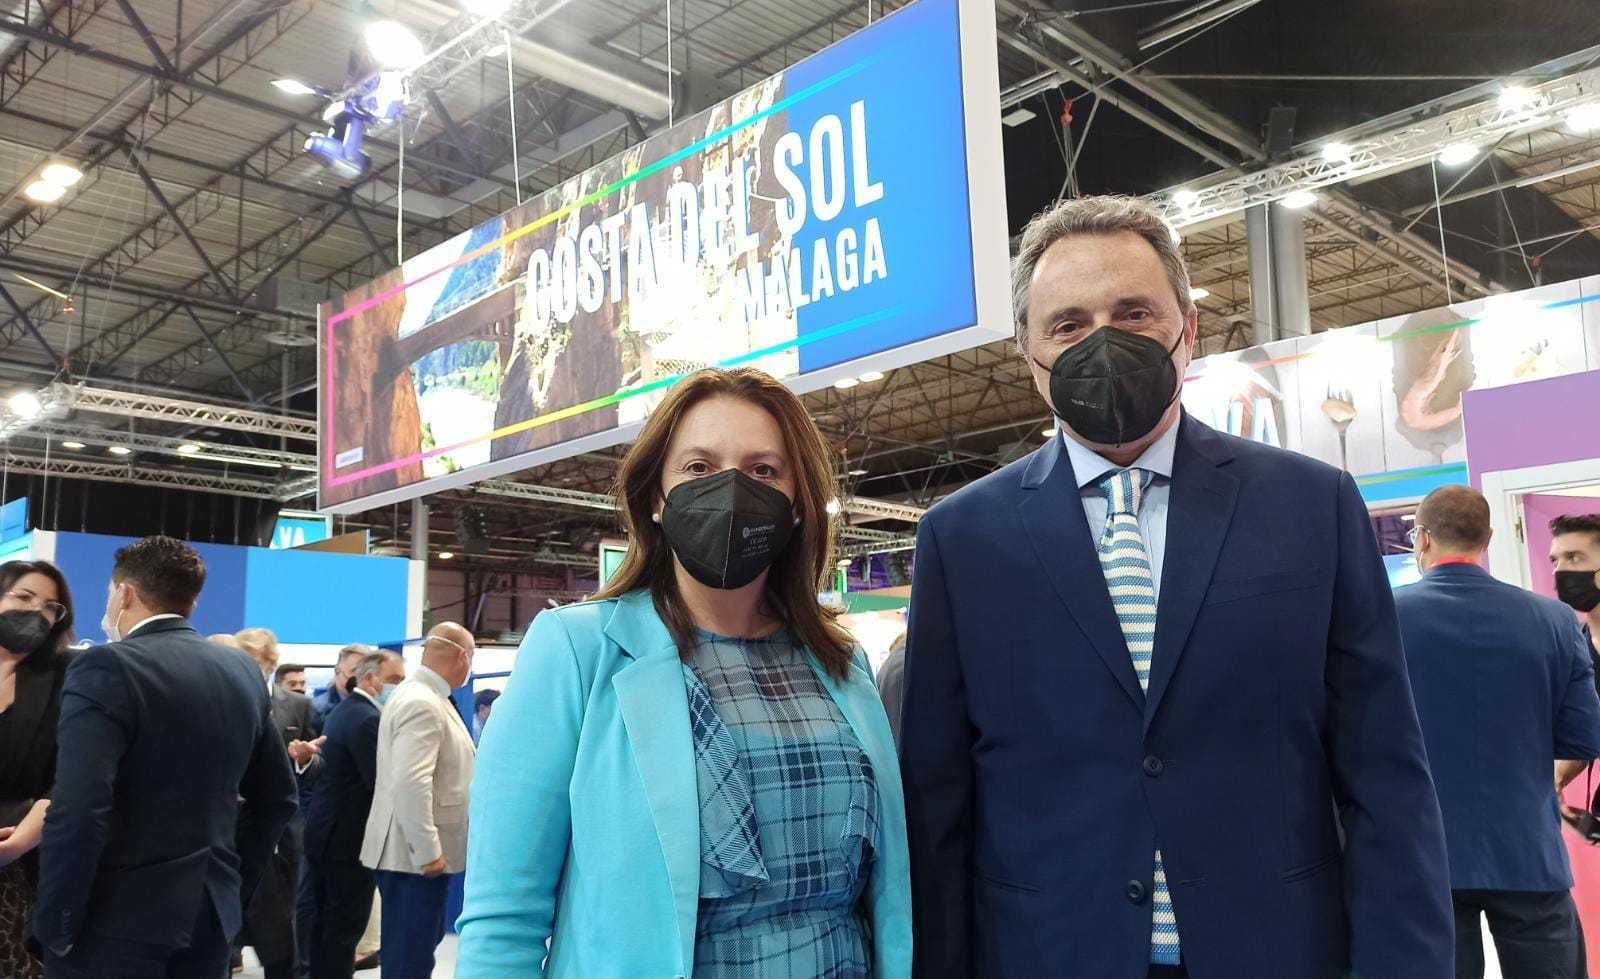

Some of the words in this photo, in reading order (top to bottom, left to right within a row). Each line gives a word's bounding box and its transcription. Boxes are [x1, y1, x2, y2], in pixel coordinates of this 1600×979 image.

[527, 202, 659, 324] COSTA
[667, 155, 760, 272] DEL
[773, 99, 885, 236] SOL
